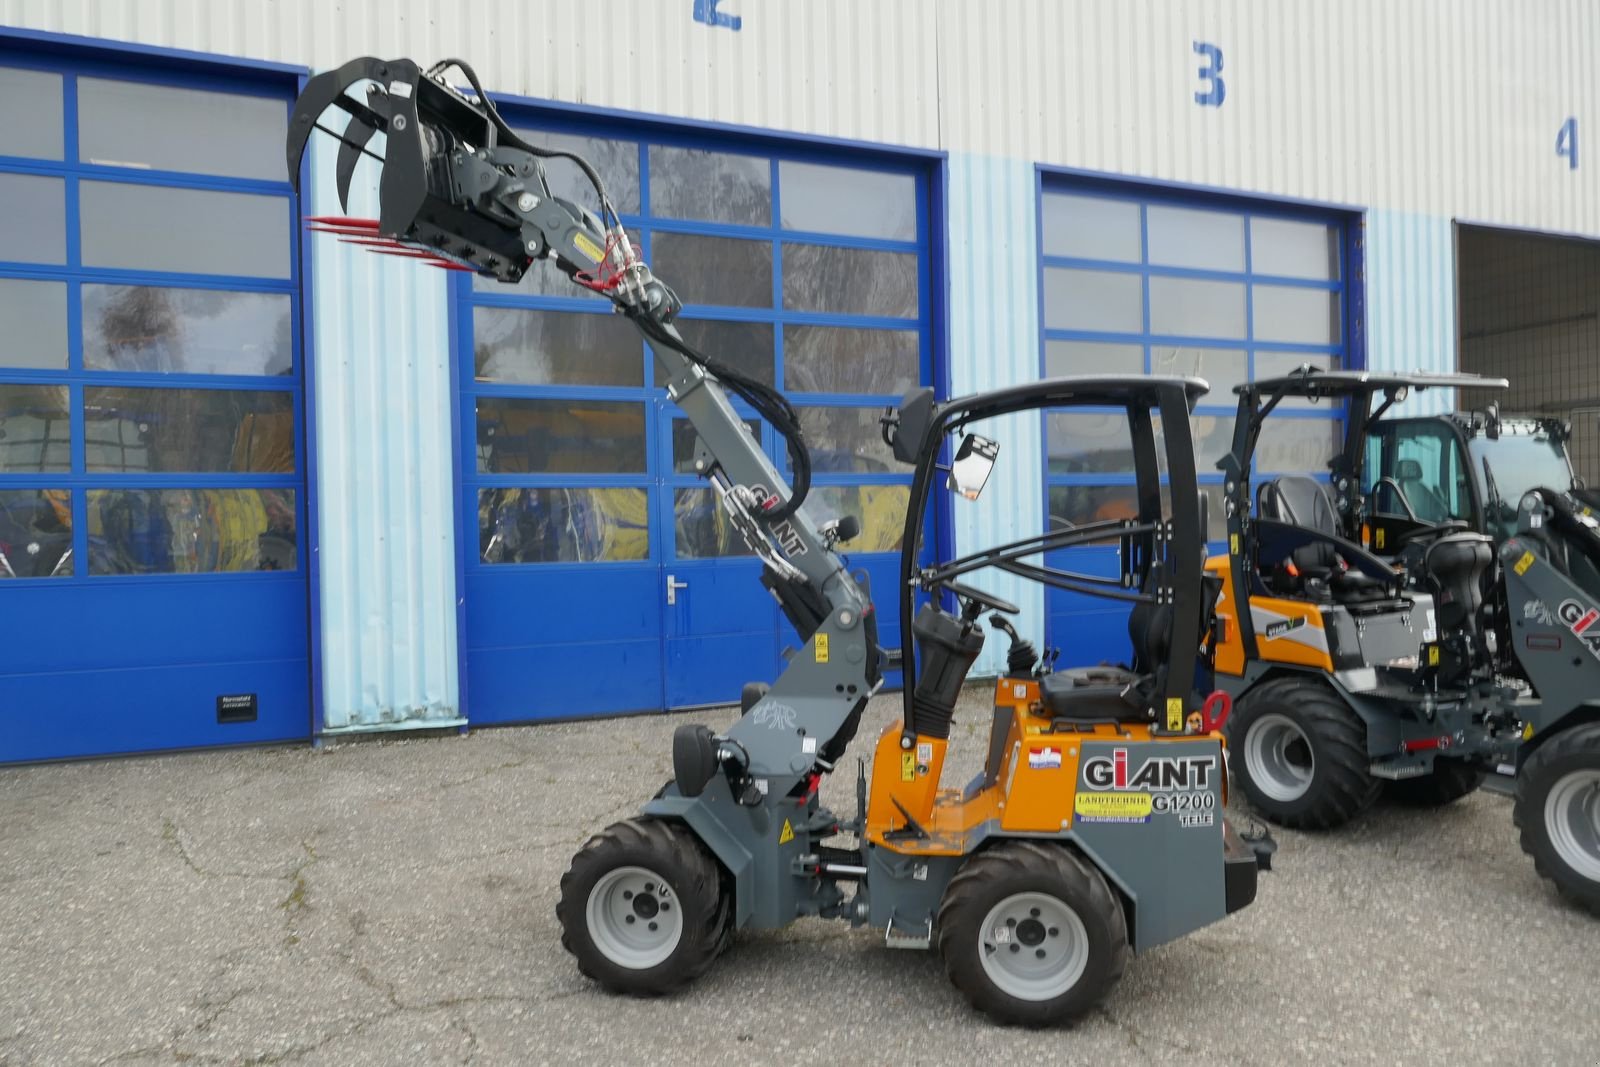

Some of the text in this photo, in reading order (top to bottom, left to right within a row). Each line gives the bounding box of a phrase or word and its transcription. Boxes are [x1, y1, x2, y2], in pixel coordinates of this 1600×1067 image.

[1193, 41, 1225, 107] 3
[1555, 117, 1578, 170] 4
[1152, 791, 1215, 814] G1200
[1179, 811, 1213, 827] TELE
